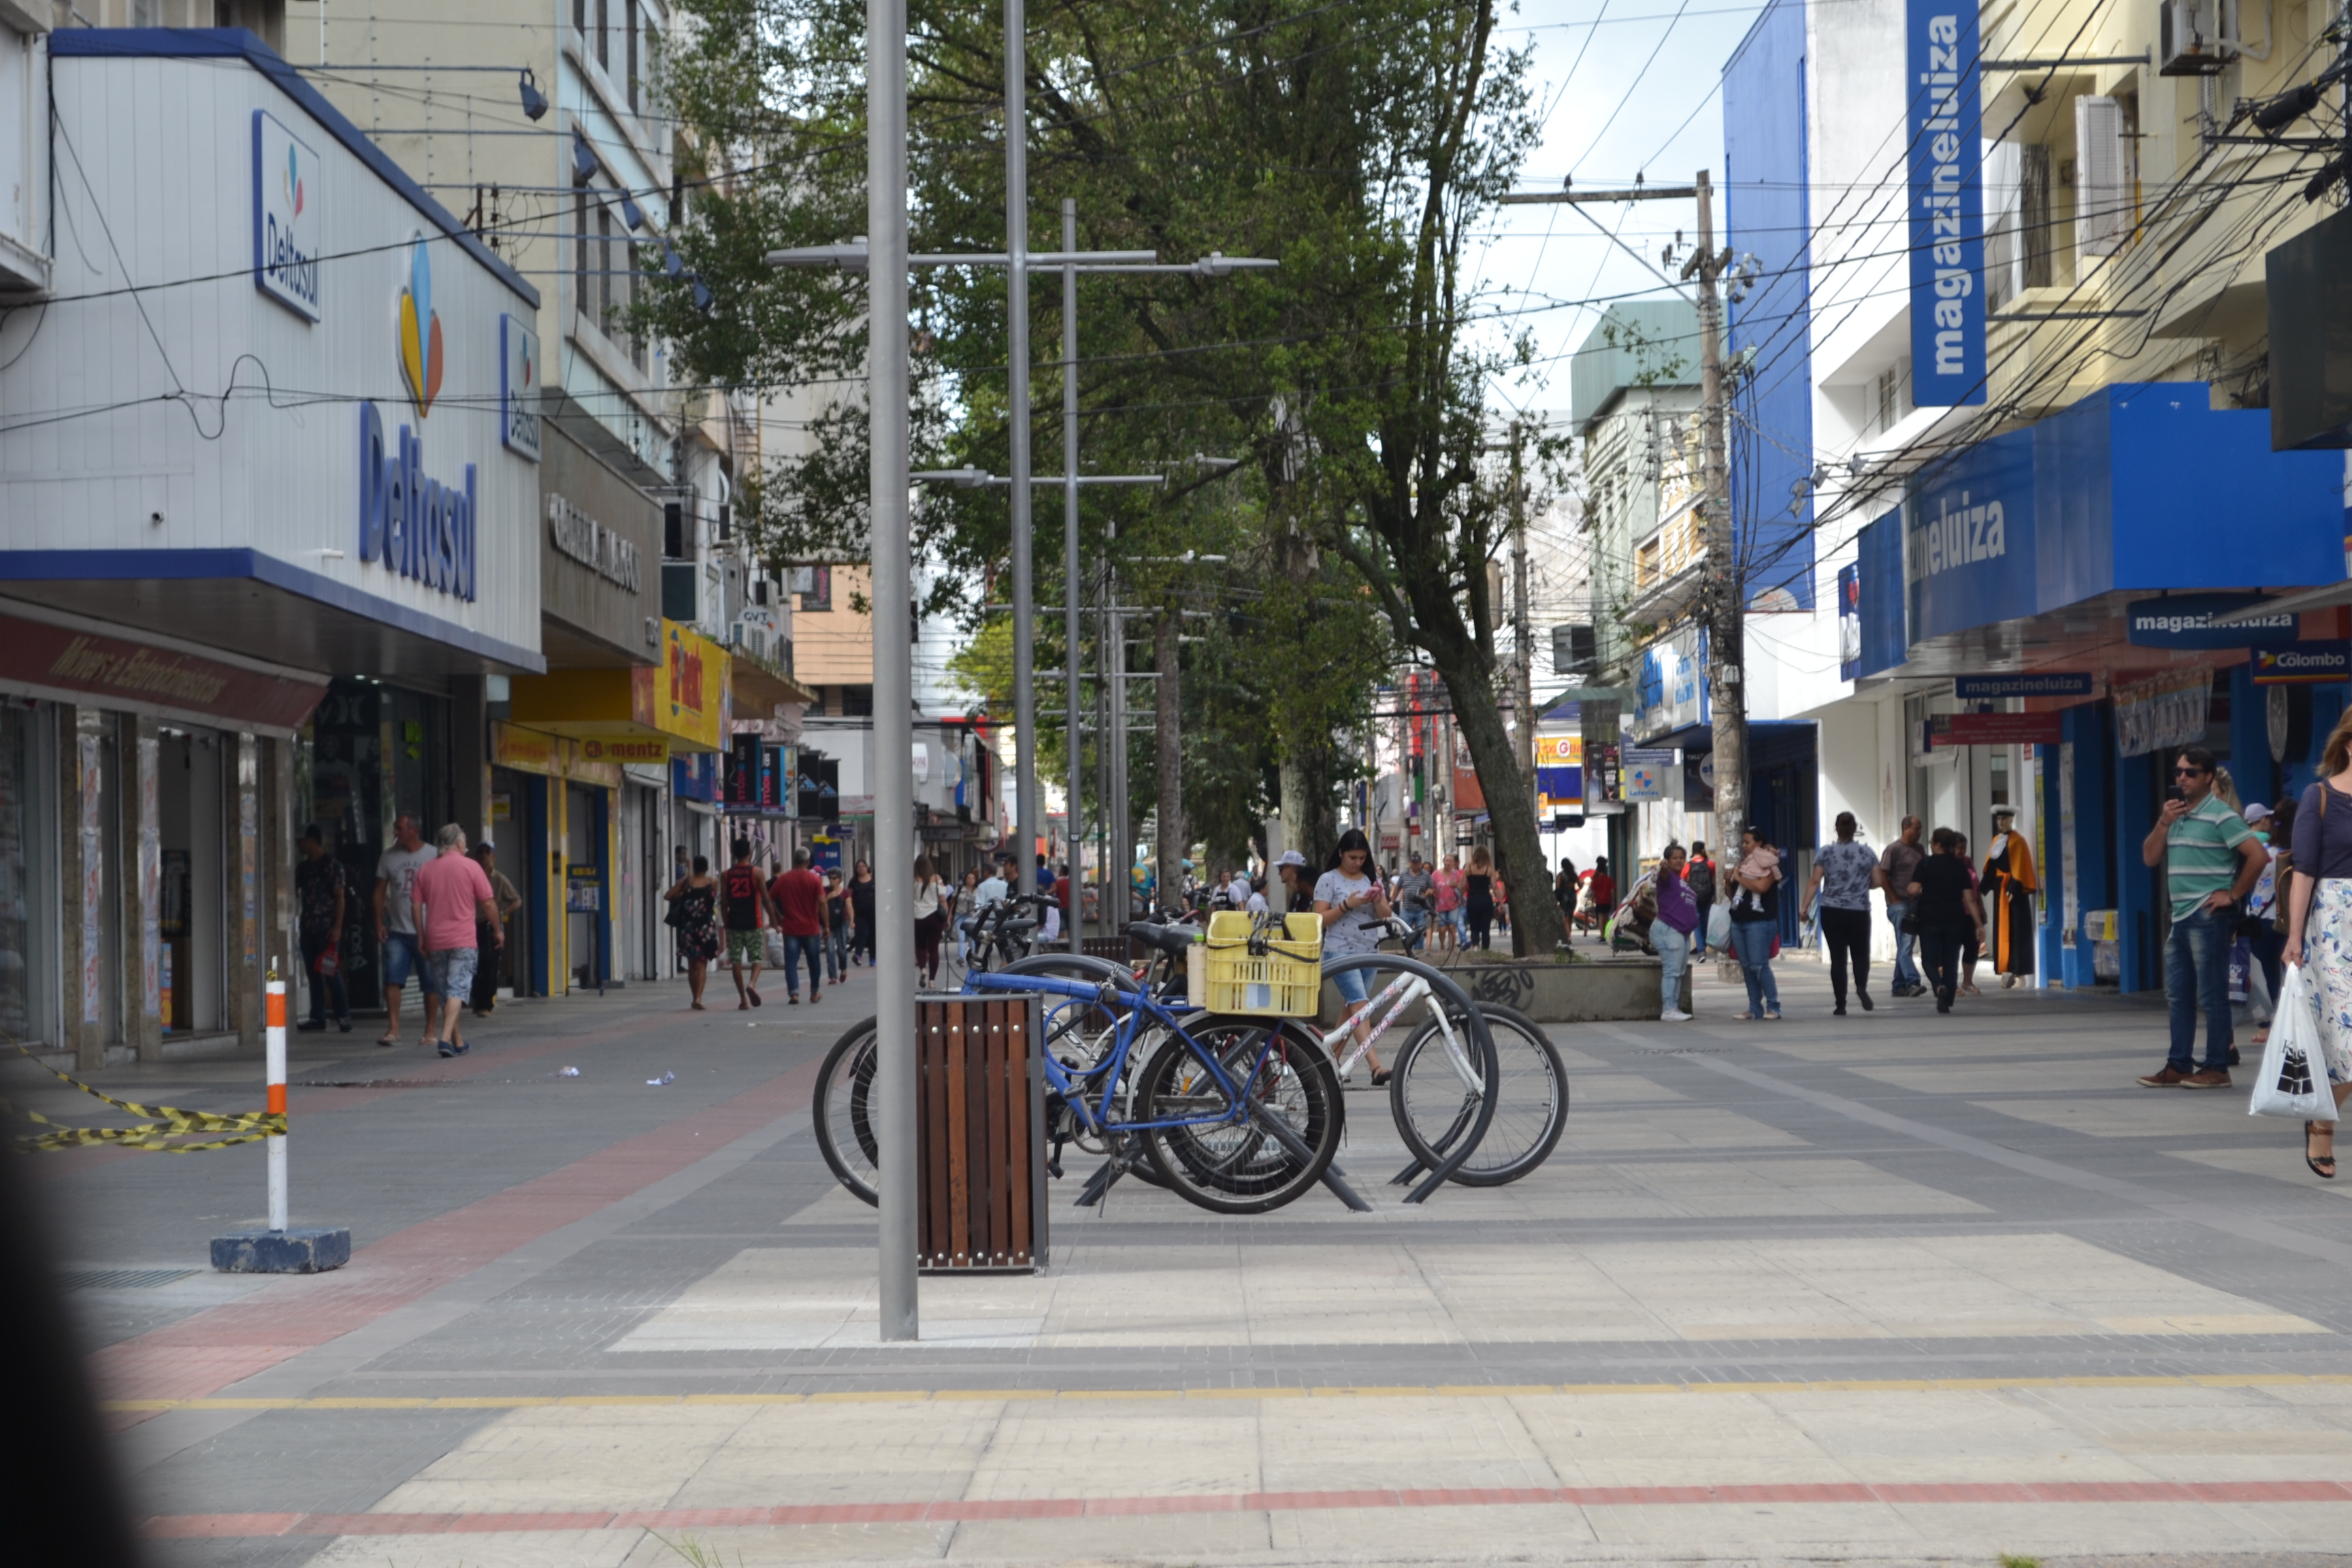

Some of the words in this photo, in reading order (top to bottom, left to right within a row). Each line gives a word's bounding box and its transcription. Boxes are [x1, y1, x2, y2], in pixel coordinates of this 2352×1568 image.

[1921, 15, 1972, 375] magazineluiza
[268, 212, 318, 307] Deltasul
[510, 389, 538, 451] Deltasul
[359, 400, 476, 603] Deltasul
[1965, 676, 2084, 695] magazineluiza
[2276, 652, 2346, 668] Colombo
[730, 877, 753, 898] 23
